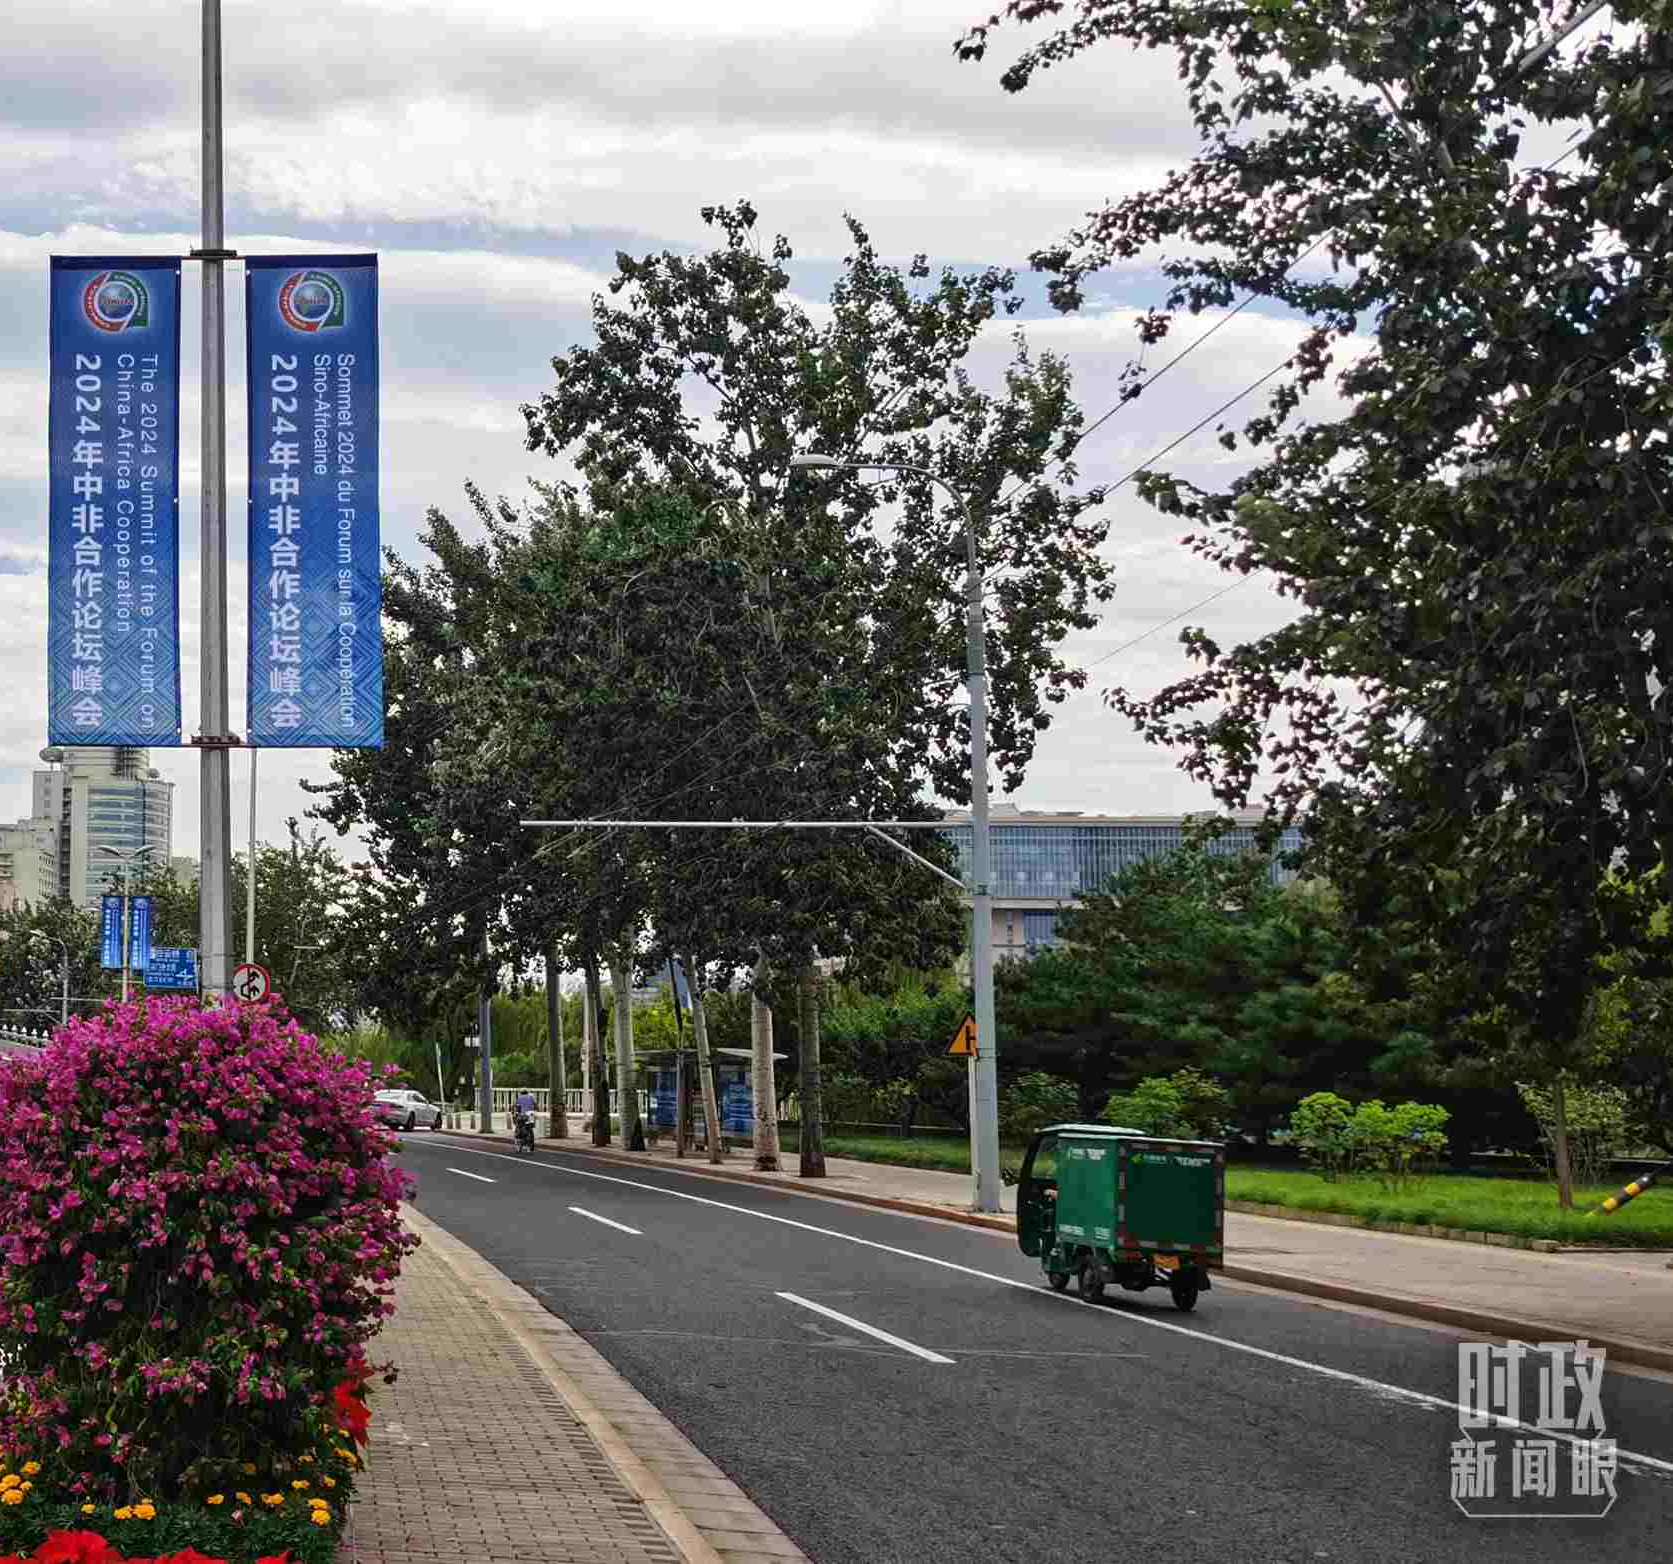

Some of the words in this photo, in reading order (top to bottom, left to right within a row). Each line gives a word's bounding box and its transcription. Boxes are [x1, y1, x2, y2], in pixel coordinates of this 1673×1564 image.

[141, 354, 158, 392] The
[337, 354, 355, 426] Sommet
[117, 354, 134, 490] China-Africa
[141, 403, 158, 454] 2024
[313, 354, 332, 475] Sino-Africaine
[337, 431, 355, 475] 2024
[141, 465, 158, 544] Summit
[337, 480, 356, 502] du
[71, 353, 104, 728] 2024年中非合作论坛峰会
[268, 354, 301, 728] 2024年中非合作论坛峰会
[337, 508, 356, 564] Forum
[113, 500, 134, 632] Cooperation
[141, 555, 158, 575] of
[337, 569, 352, 597] sur
[141, 584, 158, 617] the
[338, 602, 356, 616] la
[141, 627, 158, 693] Forum
[141, 704, 154, 728] on
